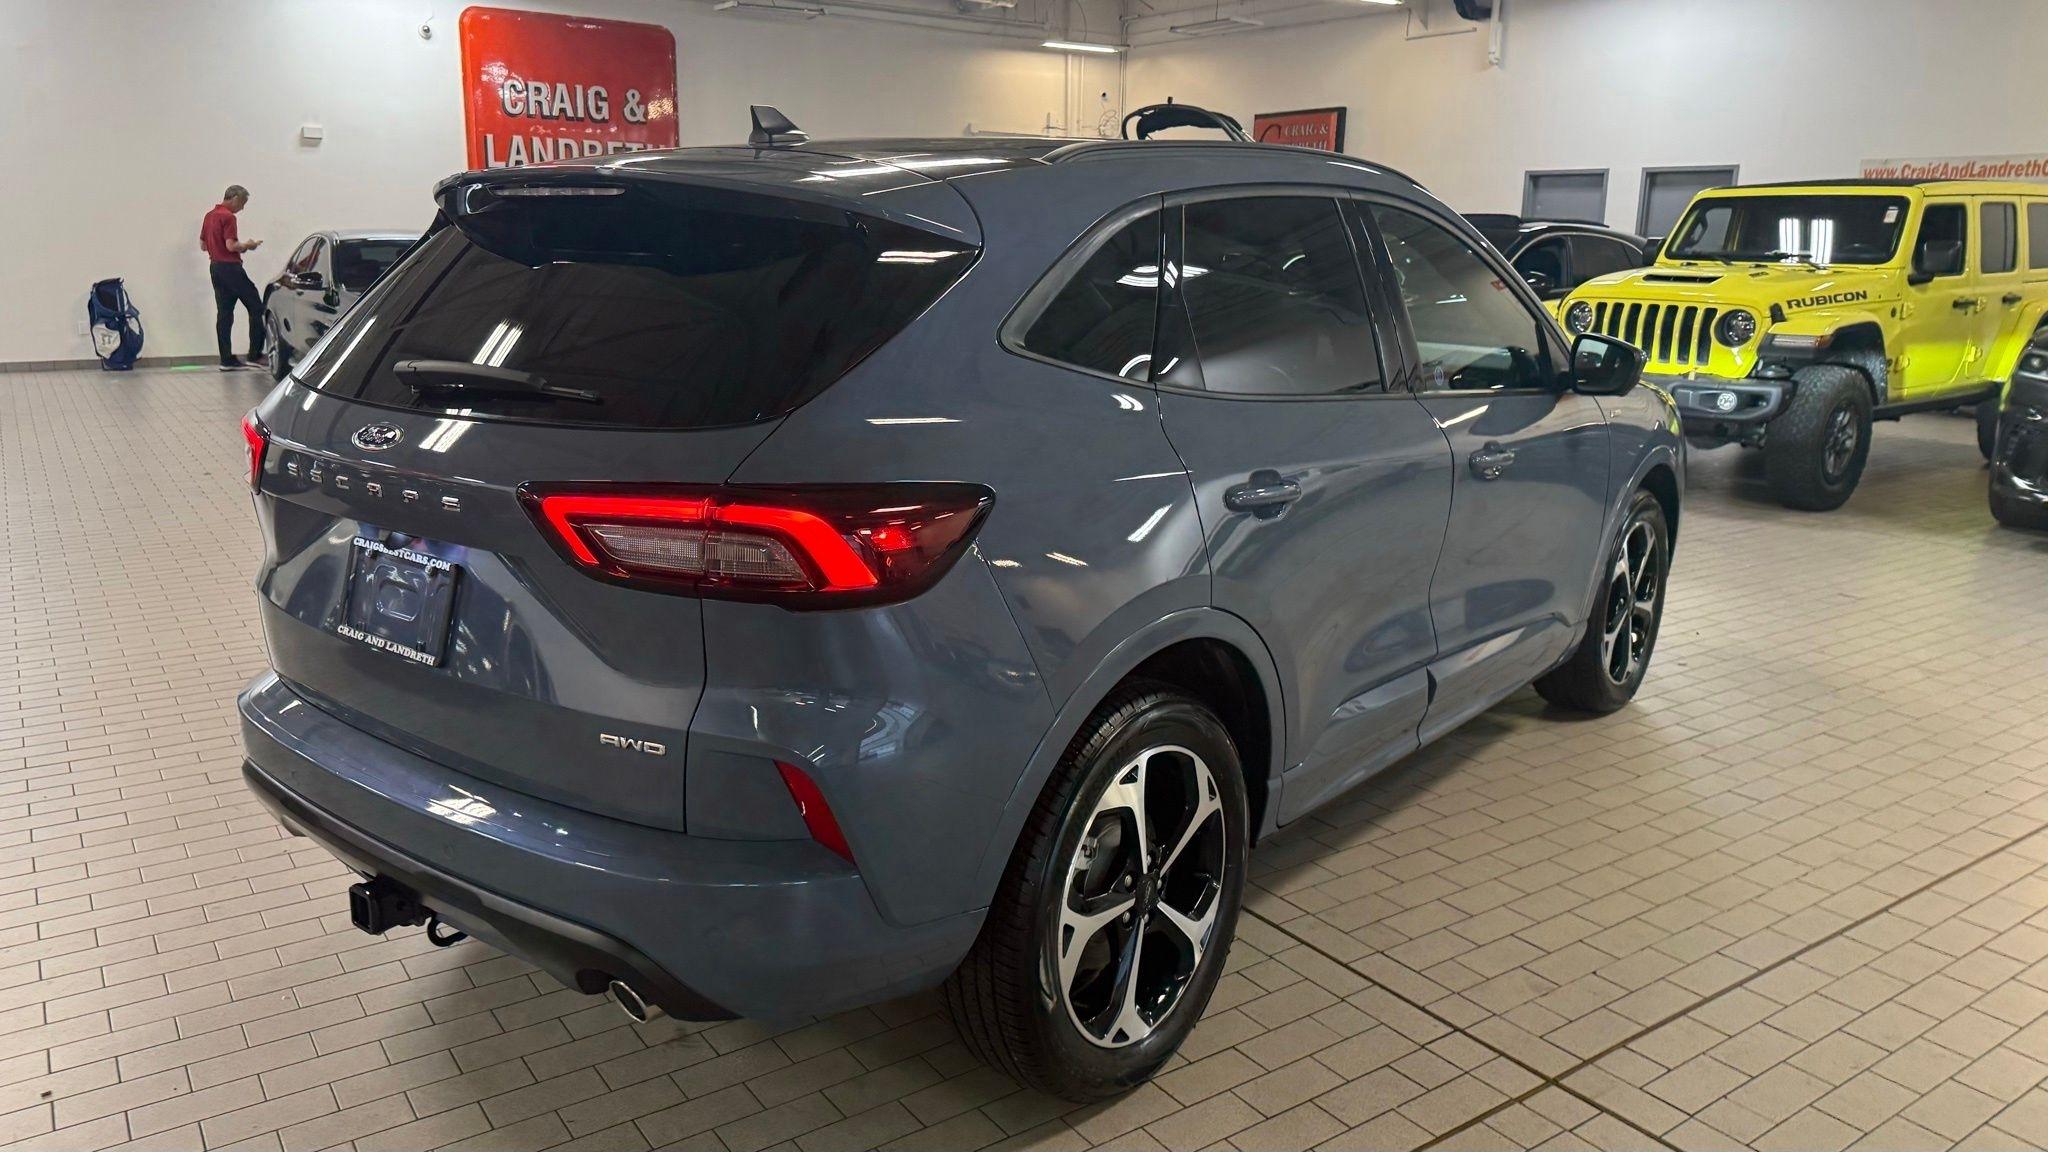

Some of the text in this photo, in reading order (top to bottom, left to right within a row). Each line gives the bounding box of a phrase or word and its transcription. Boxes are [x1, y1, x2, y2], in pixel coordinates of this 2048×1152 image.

[502, 79, 648, 124] CRAIG &
[485, 133, 667, 168] LANDR
[1786, 290, 1868, 309] RUBICON
[286, 460, 461, 513] ESCAPE
[337, 624, 436, 667] CRAIG AND LANDRETH
[600, 733, 666, 756] AWD
